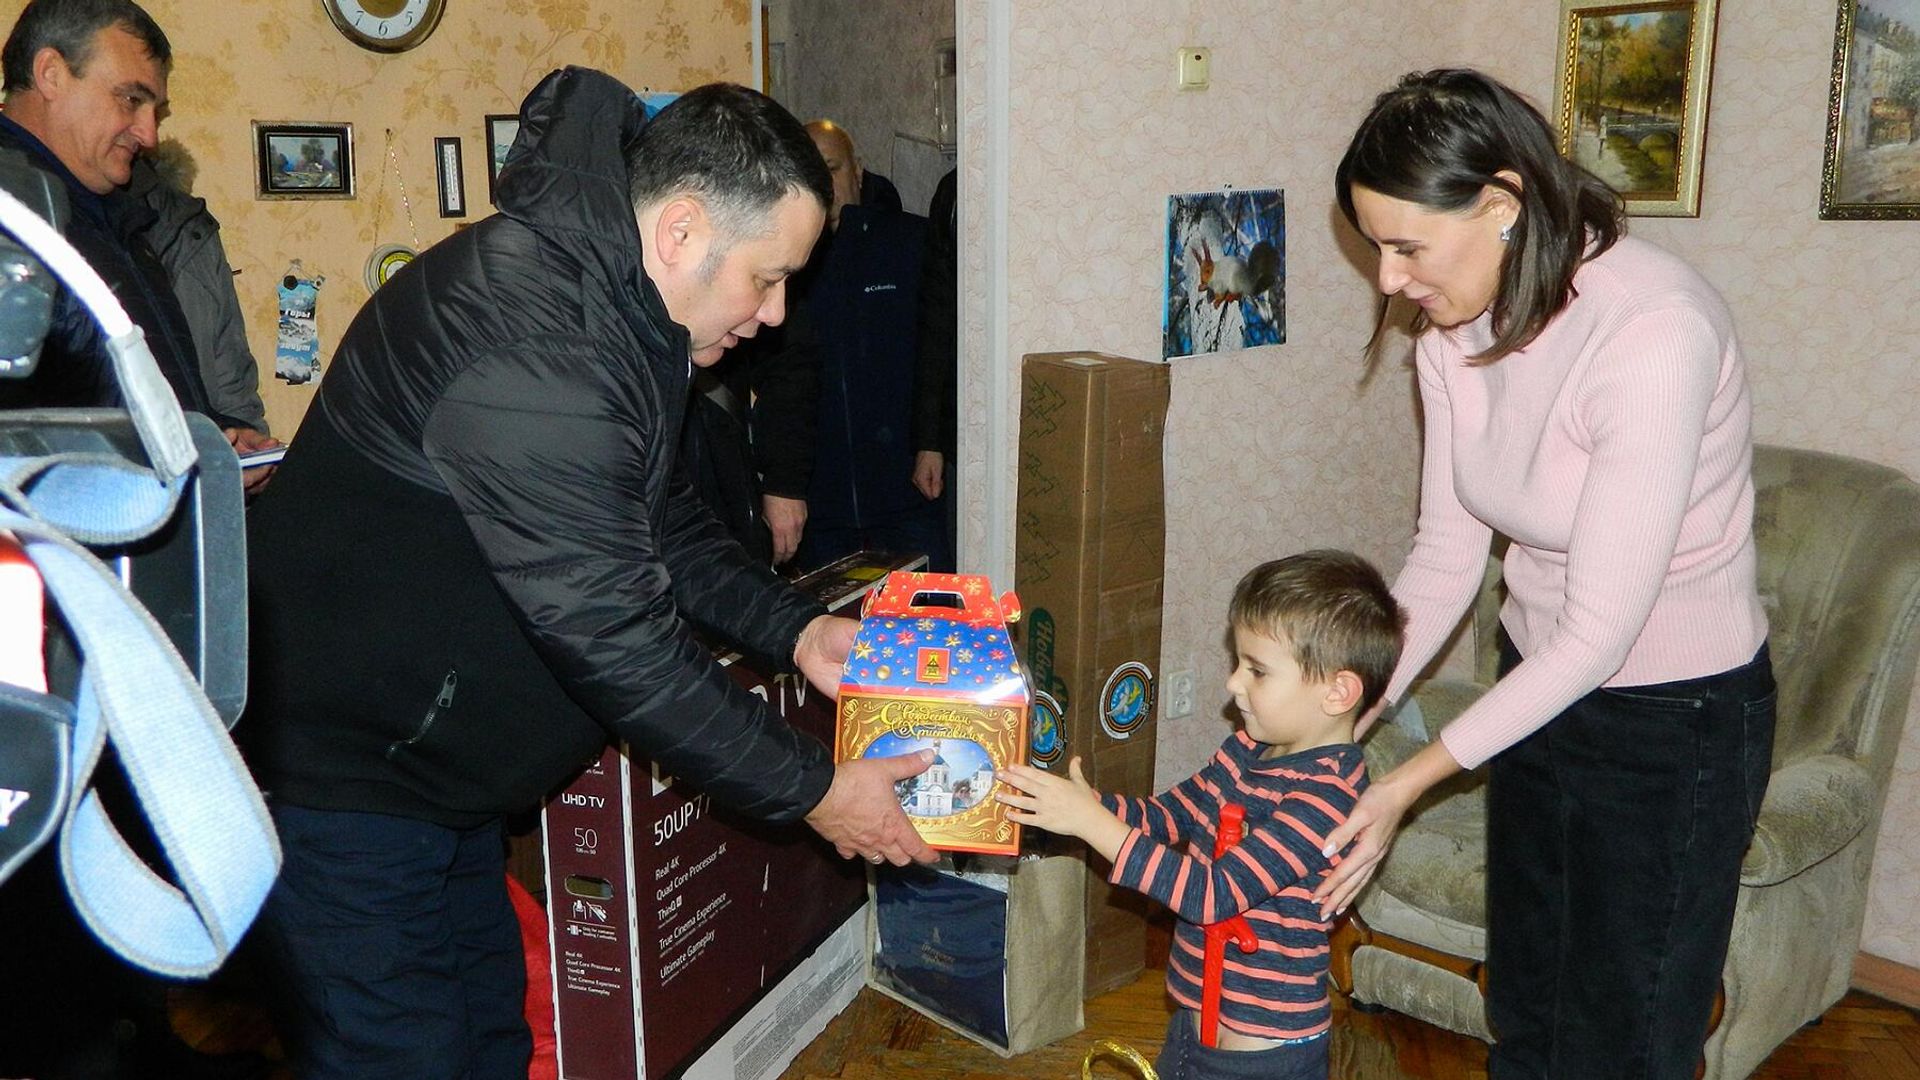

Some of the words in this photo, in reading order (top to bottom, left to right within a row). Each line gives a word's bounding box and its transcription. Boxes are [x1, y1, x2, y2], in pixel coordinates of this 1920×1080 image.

[355, 10, 364, 26] 7
[378, 20, 388, 36] 6
[404, 11, 413, 27] 5
[562, 793, 586, 806] UHD
[588, 796, 605, 808] TV
[574, 827, 598, 849] 50
[655, 862, 669, 880] Real
[670, 855, 680, 869] 4K
[656, 881, 673, 901] Quad
[674, 873, 688, 888] Core
[689, 850, 718, 877] Processor
[718, 842, 727, 855] 4K
[657, 900, 676, 921] ThinQ
[659, 934, 673, 949] True
[674, 916, 696, 938] Cinema
[696, 892, 727, 921] Experience
[660, 953, 686, 979] Ultimate
[687, 929, 715, 957] Gameplay
